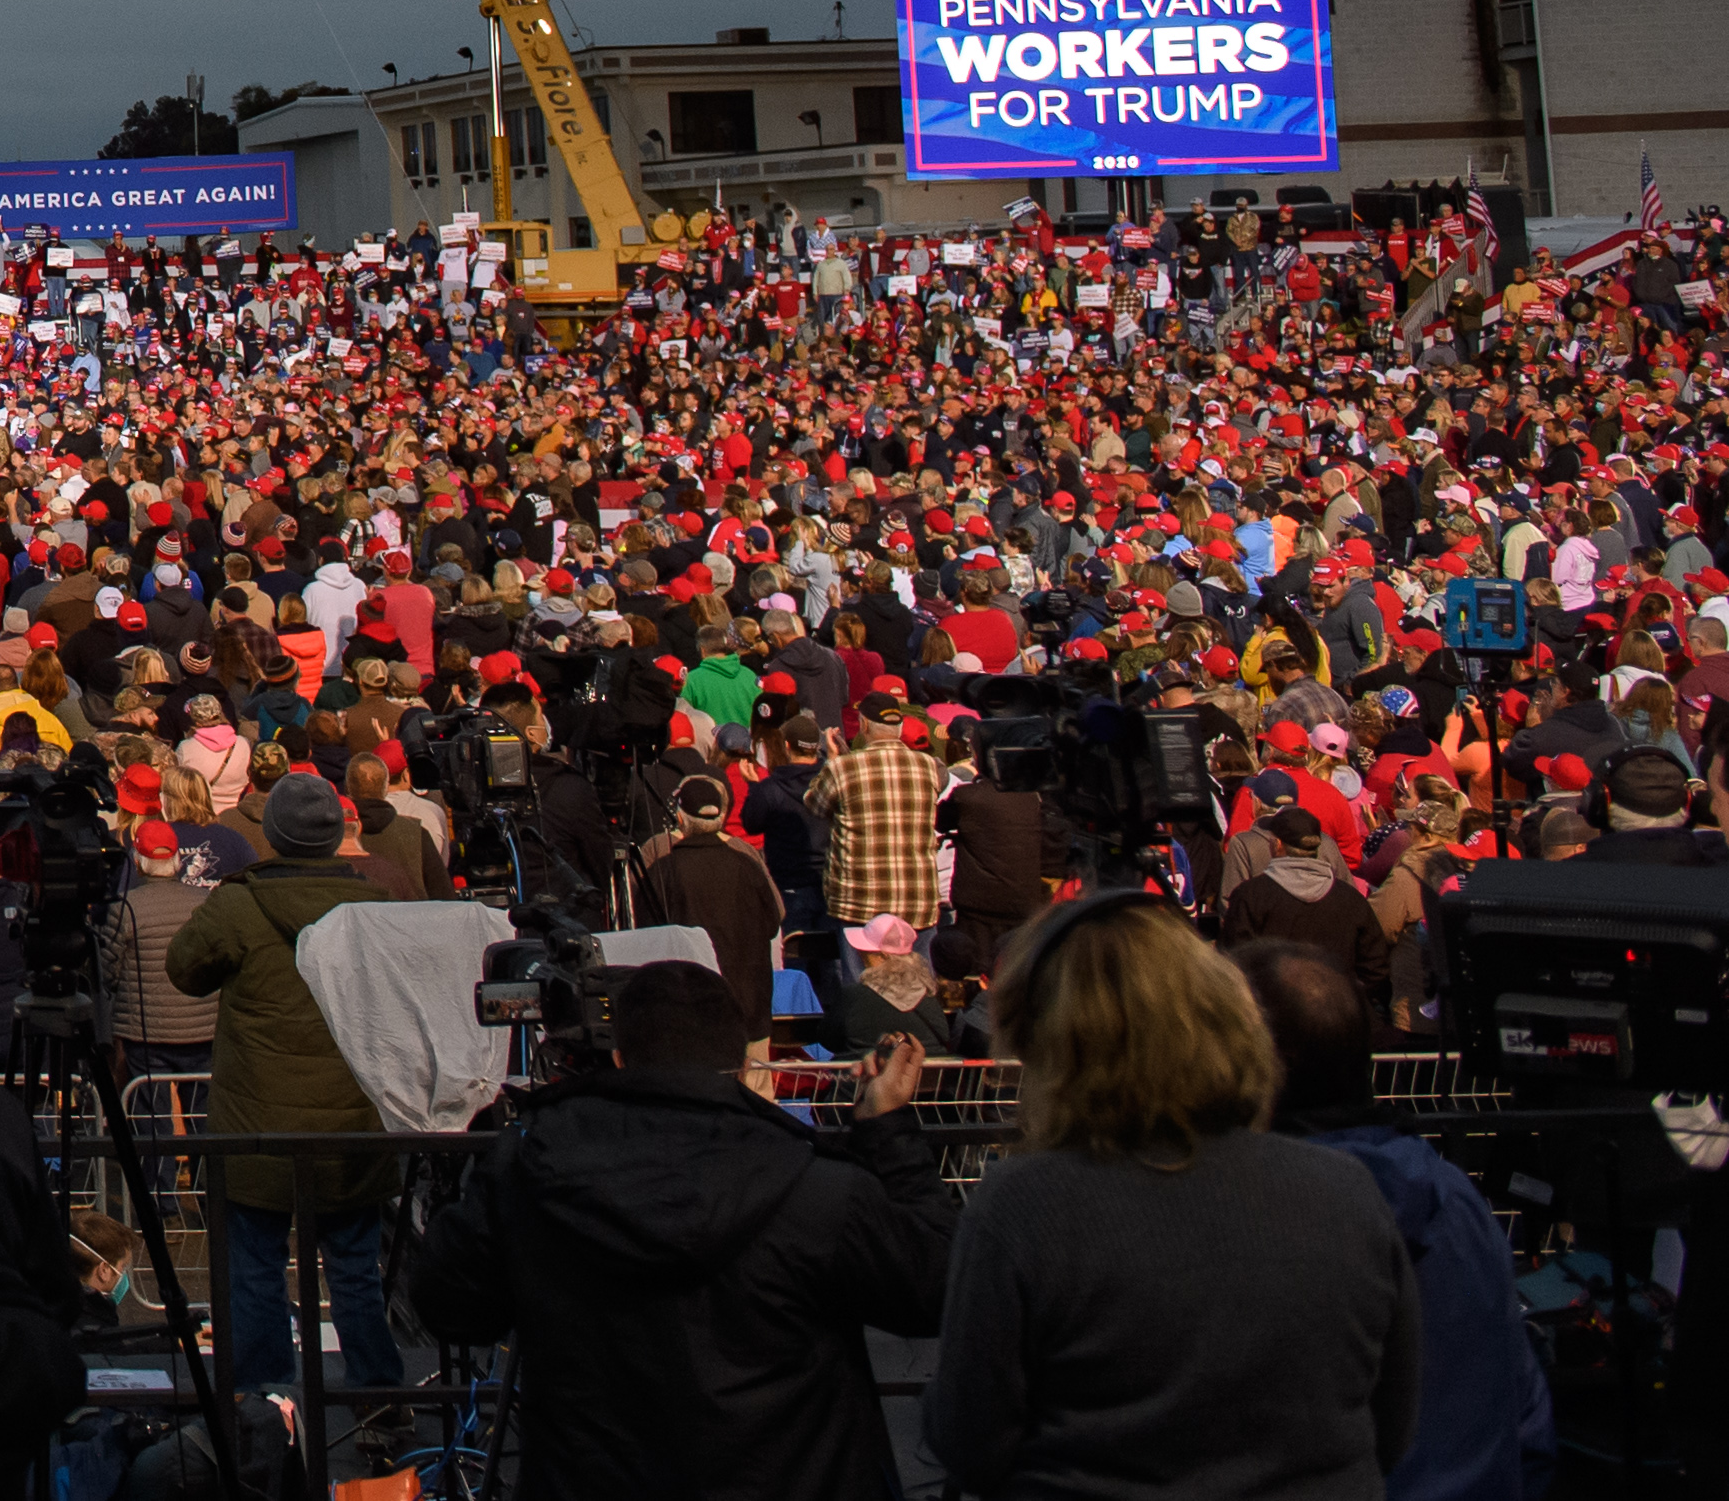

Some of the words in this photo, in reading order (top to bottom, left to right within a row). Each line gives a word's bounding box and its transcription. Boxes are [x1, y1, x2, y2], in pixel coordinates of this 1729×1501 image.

[936, 22, 1289, 83] WORKERS
[969, 89, 1071, 128] FOR
[1084, 82, 1262, 124] TRUMP
[1092, 155, 1140, 170] 2020
[110, 189, 186, 206] GREAT
[195, 184, 276, 204] AGAIN!
[1505, 1030, 1532, 1049] sk
[1569, 1035, 1612, 1055] ews
